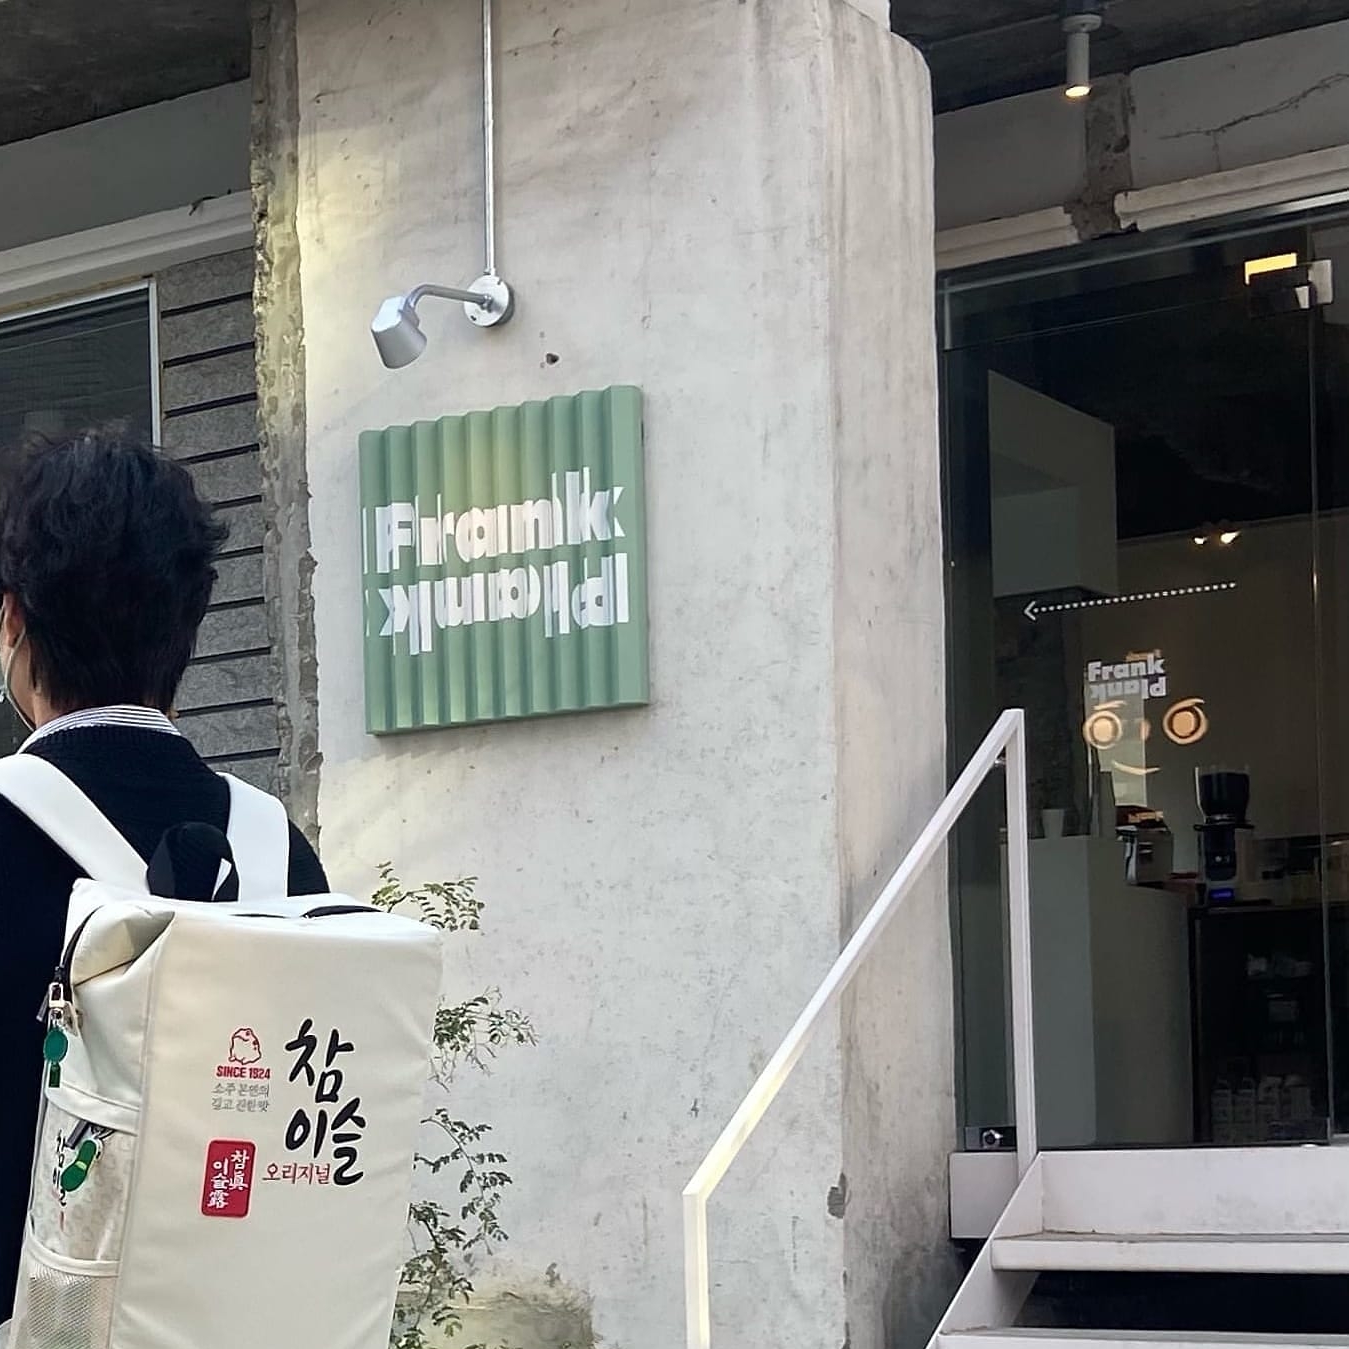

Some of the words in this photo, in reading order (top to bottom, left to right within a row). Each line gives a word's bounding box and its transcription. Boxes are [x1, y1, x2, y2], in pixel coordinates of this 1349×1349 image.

[362, 466, 625, 574] Frank
[1088, 653, 1166, 682] Frank
[216, 1066, 247, 1078] SINCE
[249, 1068, 271, 1080] 1924
[284, 1018, 355, 1104] 참
[285, 1097, 366, 1186] 이슬
[262, 1162, 331, 1185] 오리지널
